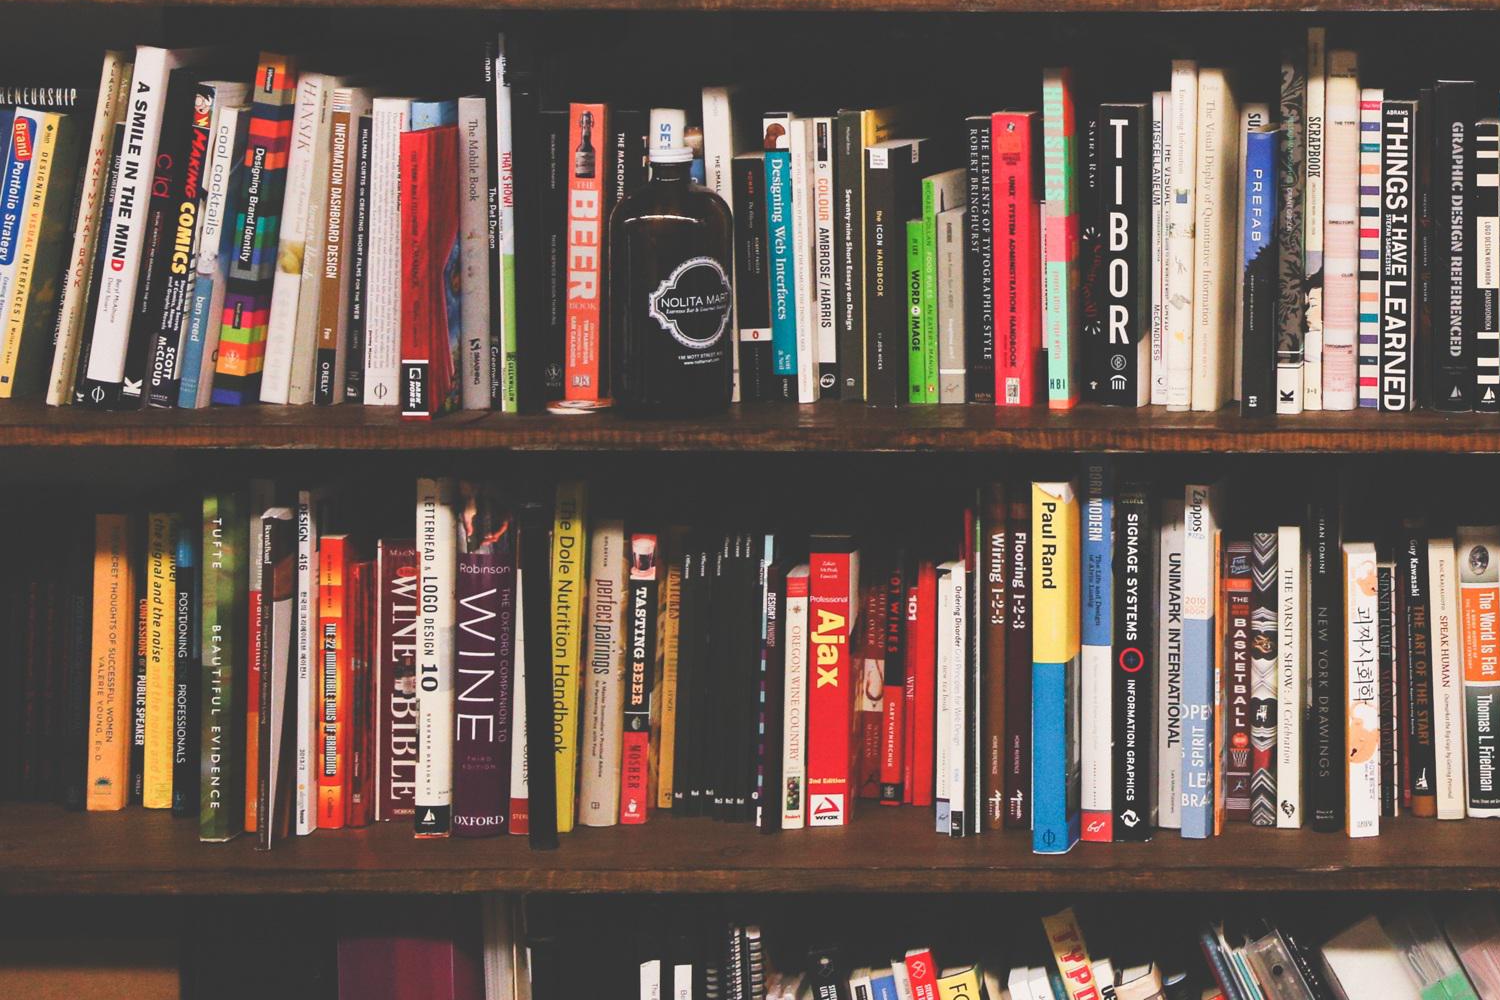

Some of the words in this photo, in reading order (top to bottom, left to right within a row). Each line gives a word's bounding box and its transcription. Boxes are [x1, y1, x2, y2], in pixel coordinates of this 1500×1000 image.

[137, 81, 150, 94] A
[15, 122, 30, 157] Brand
[127, 100, 148, 156] SMILE
[981, 128, 990, 150] THE
[1308, 117, 1321, 178] SCRAPBOOK
[124, 160, 140, 180] IN
[185, 129, 207, 199] MAKING
[250, 148, 265, 195] Designing
[332, 123, 346, 184] INFORMATION
[1386, 117, 1409, 210] THINGS
[1451, 121, 1464, 191] GRAPHIC
[7, 162, 25, 210] Portfolio
[118, 185, 136, 219] THE
[770, 159, 783, 223] Designing
[817, 178, 829, 221] COLOUR
[981, 155, 990, 215] ELEMENTS
[1251, 168, 1262, 241] PREFAB
[247, 196, 259, 225] Brand
[328, 186, 342, 246] DASHBOARD
[982, 219, 991, 232] OF
[1109, 119, 1130, 345] TIBOR
[1392, 214, 1408, 223] I
[1450, 195, 1463, 252] DESIGN
[0, 213, 16, 261] Strategy
[111, 223, 130, 272] MIND
[172, 201, 196, 275] COMICS
[239, 225, 254, 262] Identity
[569, 189, 599, 300] BEER
[774, 226, 787, 255] Web
[819, 227, 831, 279] AMBROSE
[1391, 228, 1408, 277] HAVE
[326, 248, 340, 279] DESIGN
[982, 237, 991, 322] TYPOGRAPHIC
[661, 296, 703, 308] NOLITA
[775, 258, 788, 320] Interfaces
[821, 289, 832, 328] HARRIS
[1450, 256, 1462, 357] REFERENCED
[152, 336, 167, 387] McCLOUD
[163, 347, 175, 379] SCOTT
[983, 325, 992, 360] STYLE
[1383, 281, 1407, 411] LEARNED
[424, 495, 435, 561] LETTERHEAD
[561, 501, 576, 530] The
[1042, 502, 1056, 539] Paul
[1089, 498, 1103, 541] MODERN
[1190, 489, 1206, 532] Zappos
[212, 518, 222, 569] TUFTE
[559, 536, 575, 574] Dole
[989, 533, 1005, 582] Wiring
[1012, 532, 1026, 588] Flooring
[1042, 544, 1056, 589] Rand
[1127, 513, 1139, 574] SIGNAGE
[423, 576, 438, 613] LOGO
[991, 588, 1005, 625] 1-2-3
[1012, 594, 1026, 630] 1-2-3
[1126, 578, 1138, 641] SYSTEMS
[1168, 552, 1182, 624] UNIMARK
[1480, 592, 1495, 609] The
[391, 575, 417, 662] WINE
[424, 618, 434, 656] DESIGN
[555, 580, 573, 658] Nutrition
[633, 586, 647, 659] TASTING
[1480, 613, 1496, 640] World
[211, 625, 222, 715] BEAUTIFUL
[457, 589, 497, 742] WINE
[811, 609, 845, 689] Ajax
[1233, 618, 1247, 727] BASKETBALL
[1481, 645, 1497, 653] Is
[1481, 655, 1497, 676] Flat
[421, 664, 439, 692] 10
[632, 662, 644, 705] BEER
[1167, 625, 1181, 748] INTERNATIONAL
[553, 664, 570, 753] Handbook
[1127, 679, 1136, 748] INFORMATION
[1477, 694, 1493, 733] Thomas
[391, 693, 417, 800] BIBLE
[1478, 736, 1494, 744] L.
[210, 726, 221, 809] EVIDENCE
[1126, 750, 1135, 801] GRAPHICS
[1479, 746, 1495, 791] Friedman
